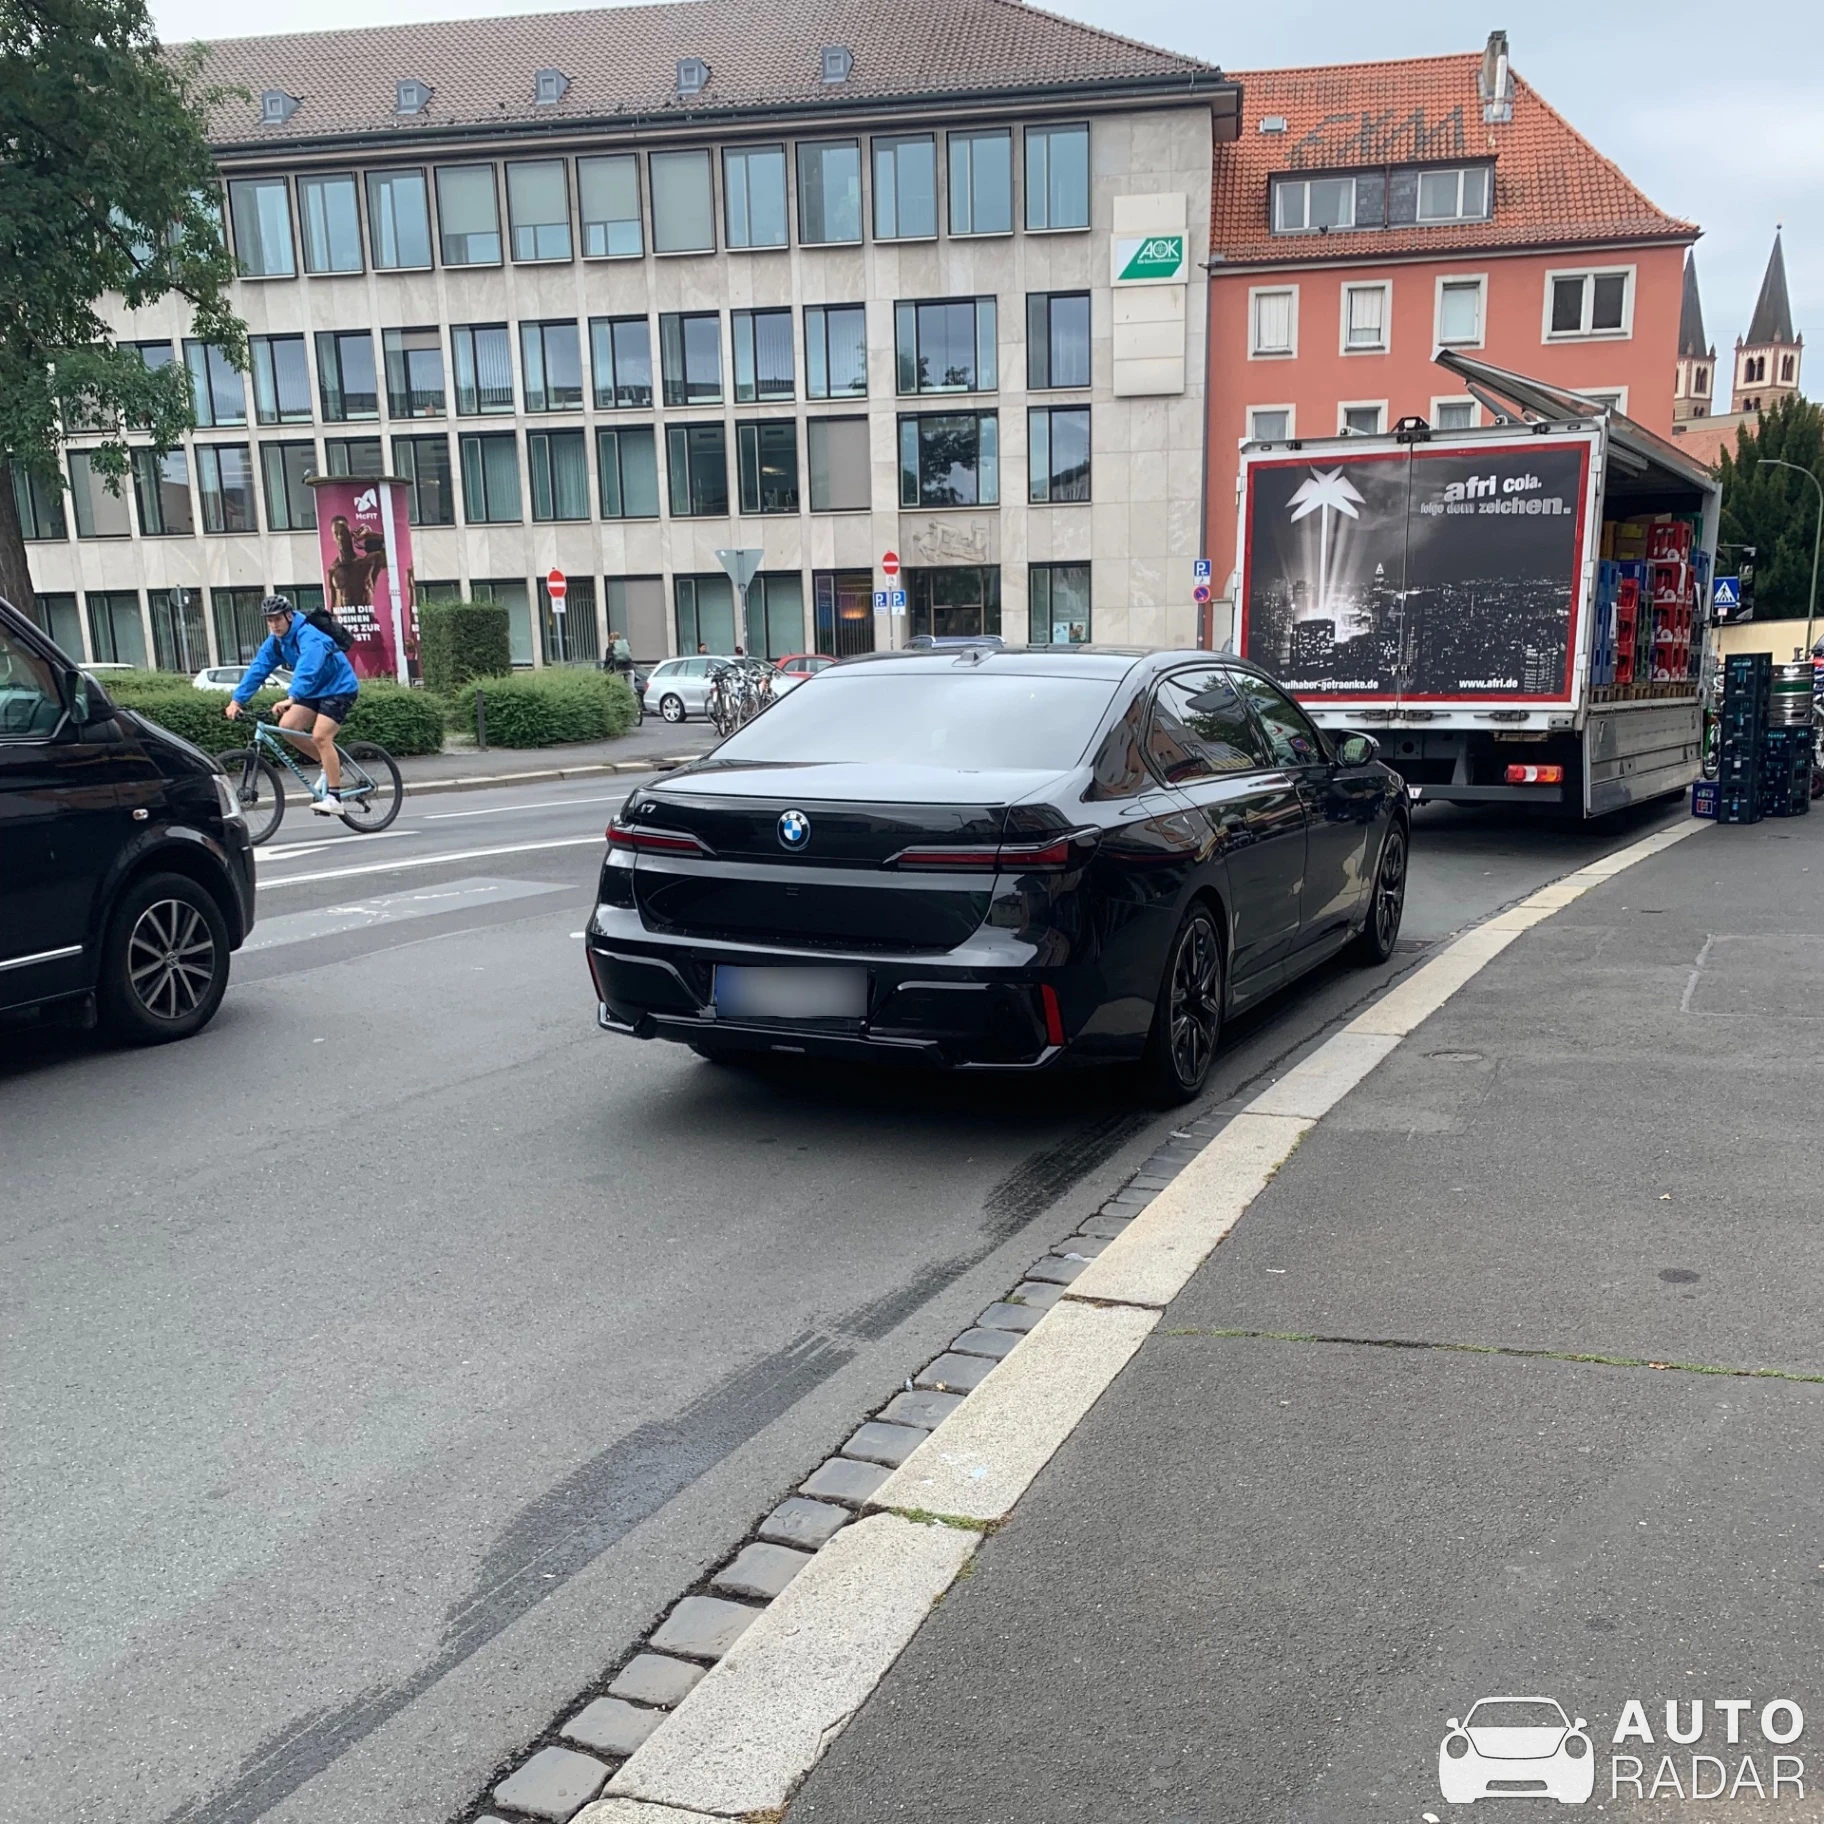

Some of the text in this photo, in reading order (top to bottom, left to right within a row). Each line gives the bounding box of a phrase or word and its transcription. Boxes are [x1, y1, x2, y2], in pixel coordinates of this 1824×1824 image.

[1138, 239, 1180, 259] AOK
[1444, 474, 1542, 502] afri cola.
[1420, 502, 1444, 516] folge
[1478, 497, 1572, 515] zeichen.
[355, 512, 378, 520] McFIT
[1196, 562, 1206, 576] P
[875, 593, 883, 607] P
[893, 592, 901, 606] P
[357, 604, 376, 614] DIR
[337, 614, 370, 625] DEINEN
[360, 623, 381, 632] ZUR
[1278, 680, 1379, 691] aulhaber-getraenke.de
[1459, 677, 1518, 688] www.afri.de
